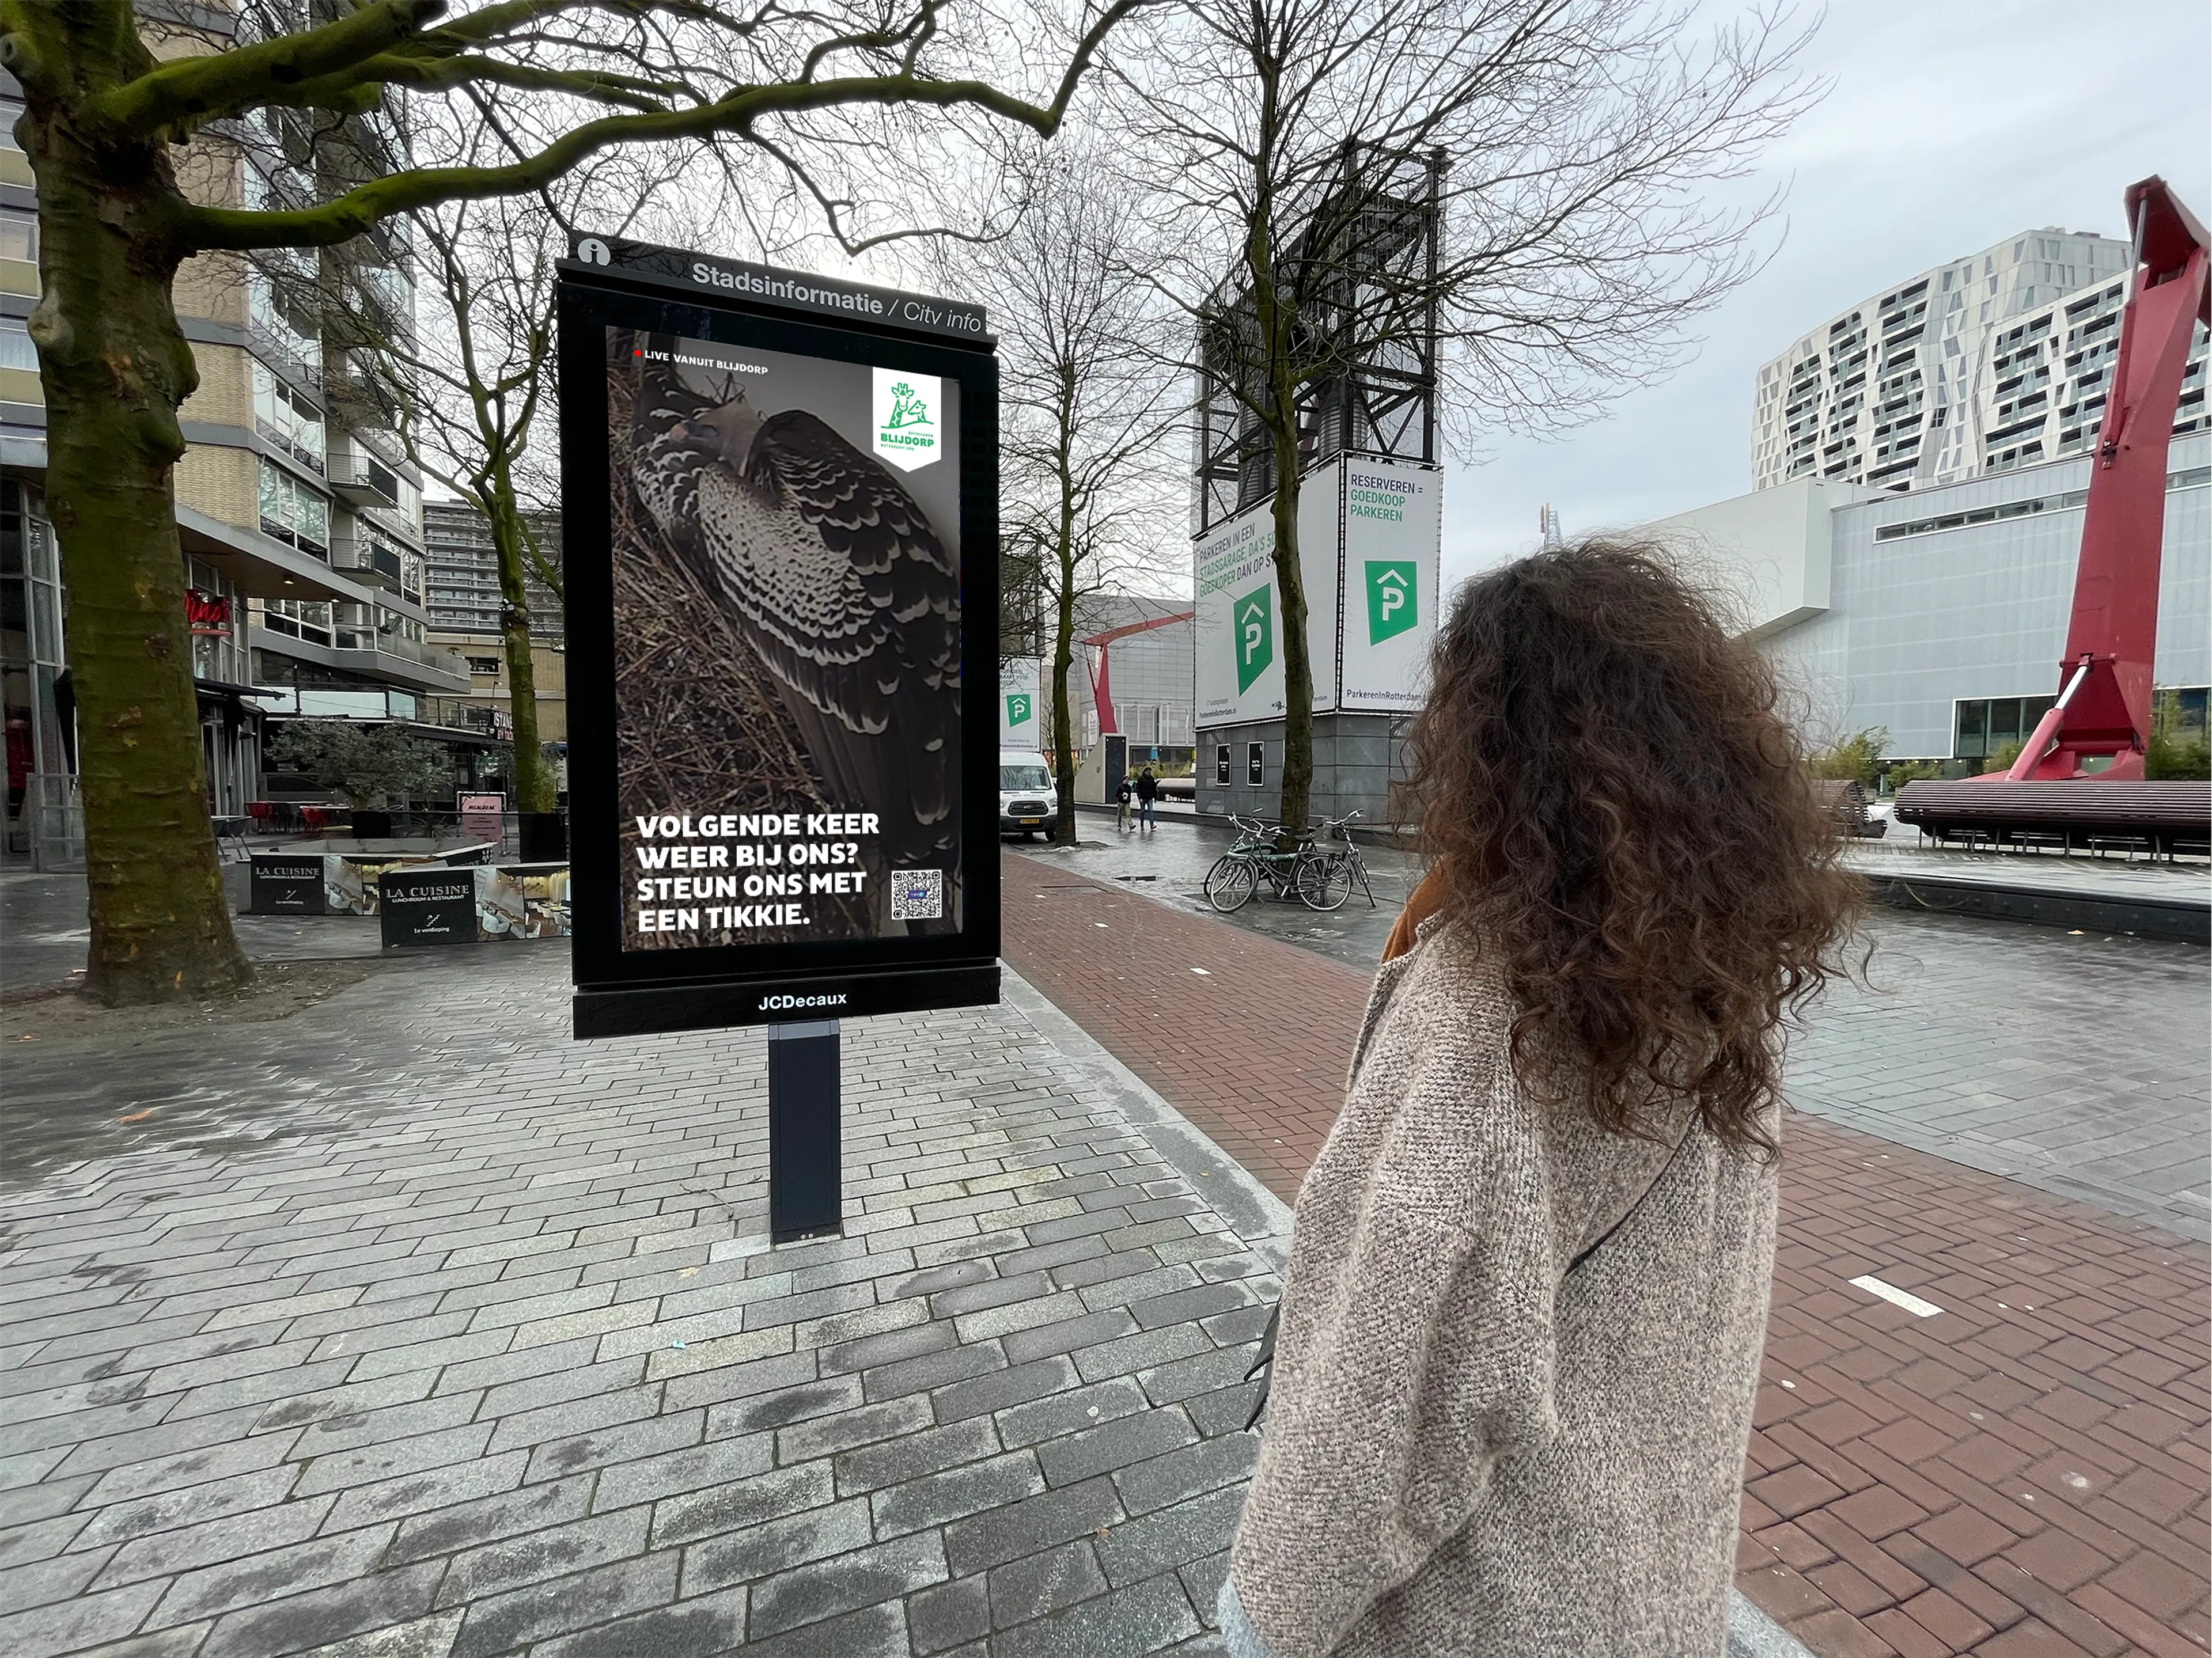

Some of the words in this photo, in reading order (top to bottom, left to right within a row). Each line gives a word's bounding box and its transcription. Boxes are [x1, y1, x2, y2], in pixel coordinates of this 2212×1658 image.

[692, 263, 884, 314] Stadsinformatie
[946, 309, 982, 332] info
[645, 350, 669, 362] LIVE
[673, 354, 714, 368] VANUIT
[717, 360, 769, 375] BLIJDORP
[880, 432, 934, 447] BLIJDORP
[1351, 474, 1415, 494] RESERVEREN
[1351, 489, 1406, 507] GOEDKOOP
[1351, 504, 1403, 522] PARKEREN
[1199, 535, 1232, 564] PARKEREN
[1233, 530, 1240, 548] IN
[1241, 522, 1255, 542] EEN
[1199, 546, 1247, 579] STADSGARAGE,
[1248, 536, 1266, 558] DA'S
[1199, 569, 1236, 598] GOEDKOPER
[1237, 561, 1252, 582] DAN
[1253, 556, 1264, 574] OP
[1347, 689, 1421, 701] ParkerenInRotterdam
[635, 814, 800, 839] VOLGENDE
[808, 813, 880, 835] KEER
[635, 845, 729, 870] WEER
[736, 844, 782, 867] BIJ
[789, 843, 858, 866] ONS?
[255, 867, 270, 875] LA
[274, 867, 320, 876] CUISINE
[385, 888, 404, 898] LA
[409, 884, 470, 897] CUISINE
[637, 875, 737, 901] STEUN
[744, 874, 802, 897] ONS
[809, 871, 867, 894] MET
[638, 908, 699, 932] EEN
[705, 903, 810, 928] TIKKIE.
[758, 993, 847, 1011] JCDecaux
